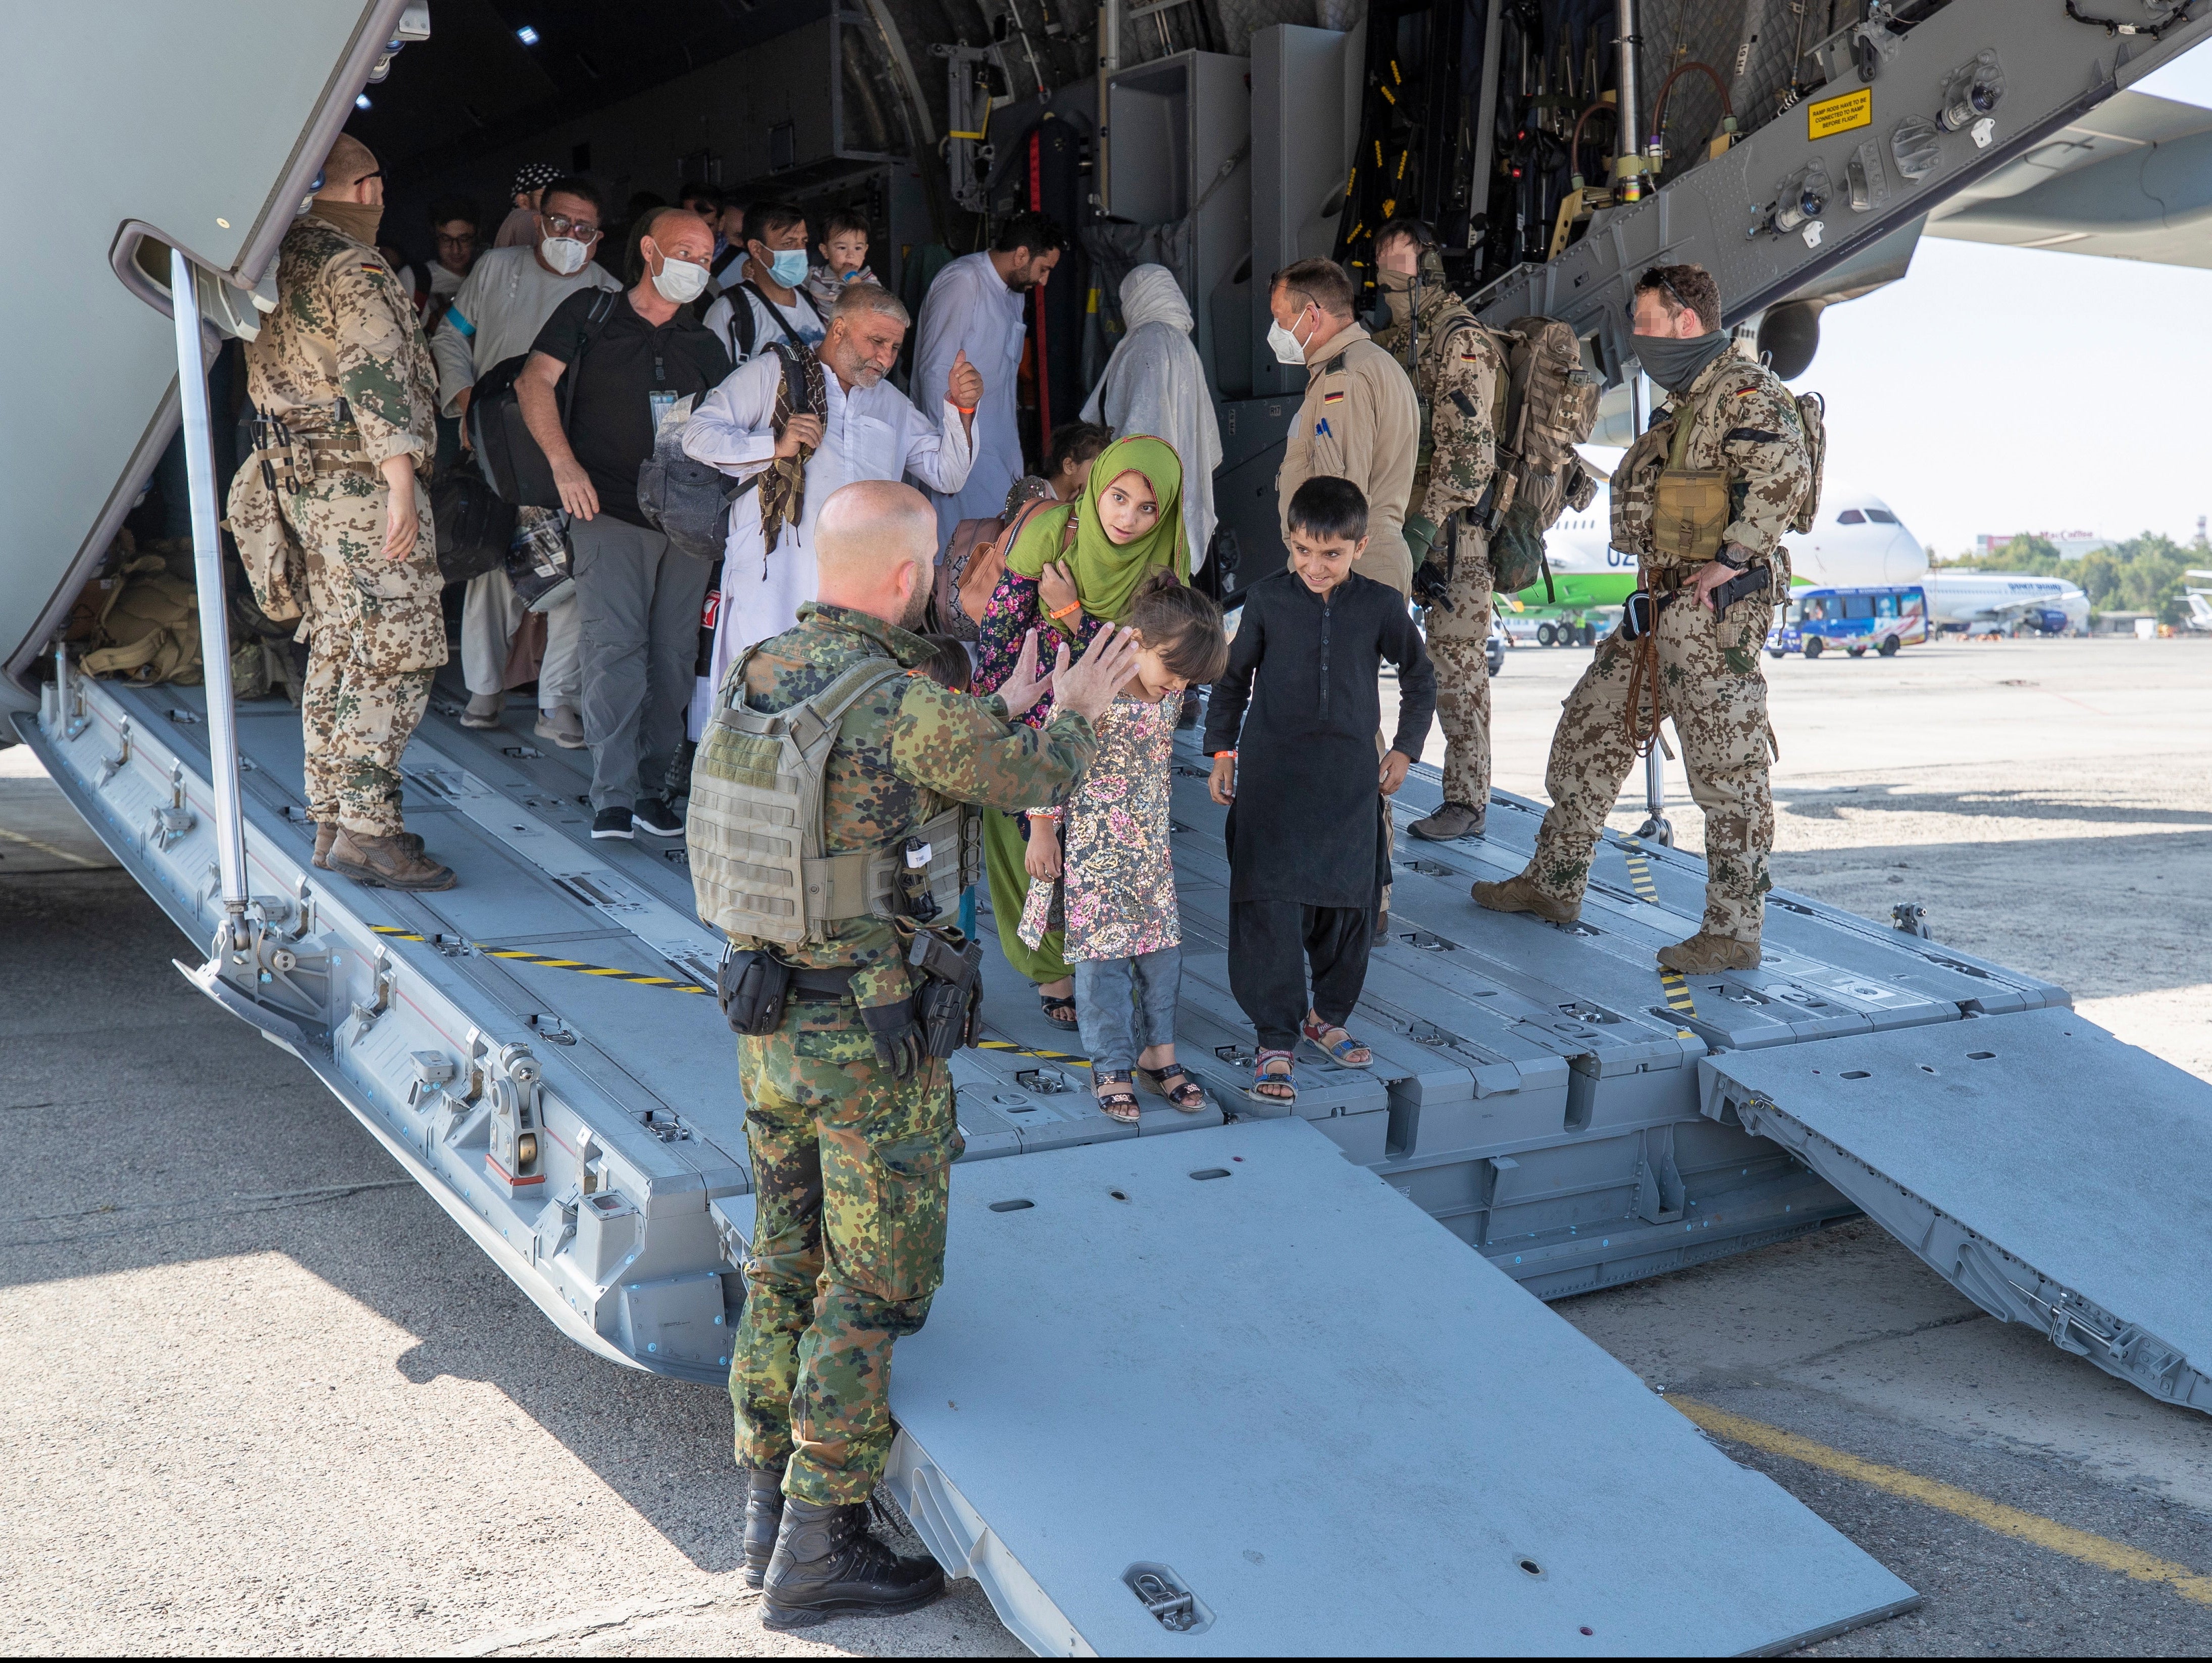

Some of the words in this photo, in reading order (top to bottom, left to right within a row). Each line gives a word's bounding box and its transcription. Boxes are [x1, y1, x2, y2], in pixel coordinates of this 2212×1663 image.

[1813, 109, 1826, 117] RAMP
[1826, 105, 1839, 113] RODS
[1815, 111, 1843, 123] CONNECTED
[1850, 105, 1865, 113] RAMP
[1822, 119, 1841, 128] BEFORE
[1841, 114, 1859, 123] FLIGHT
